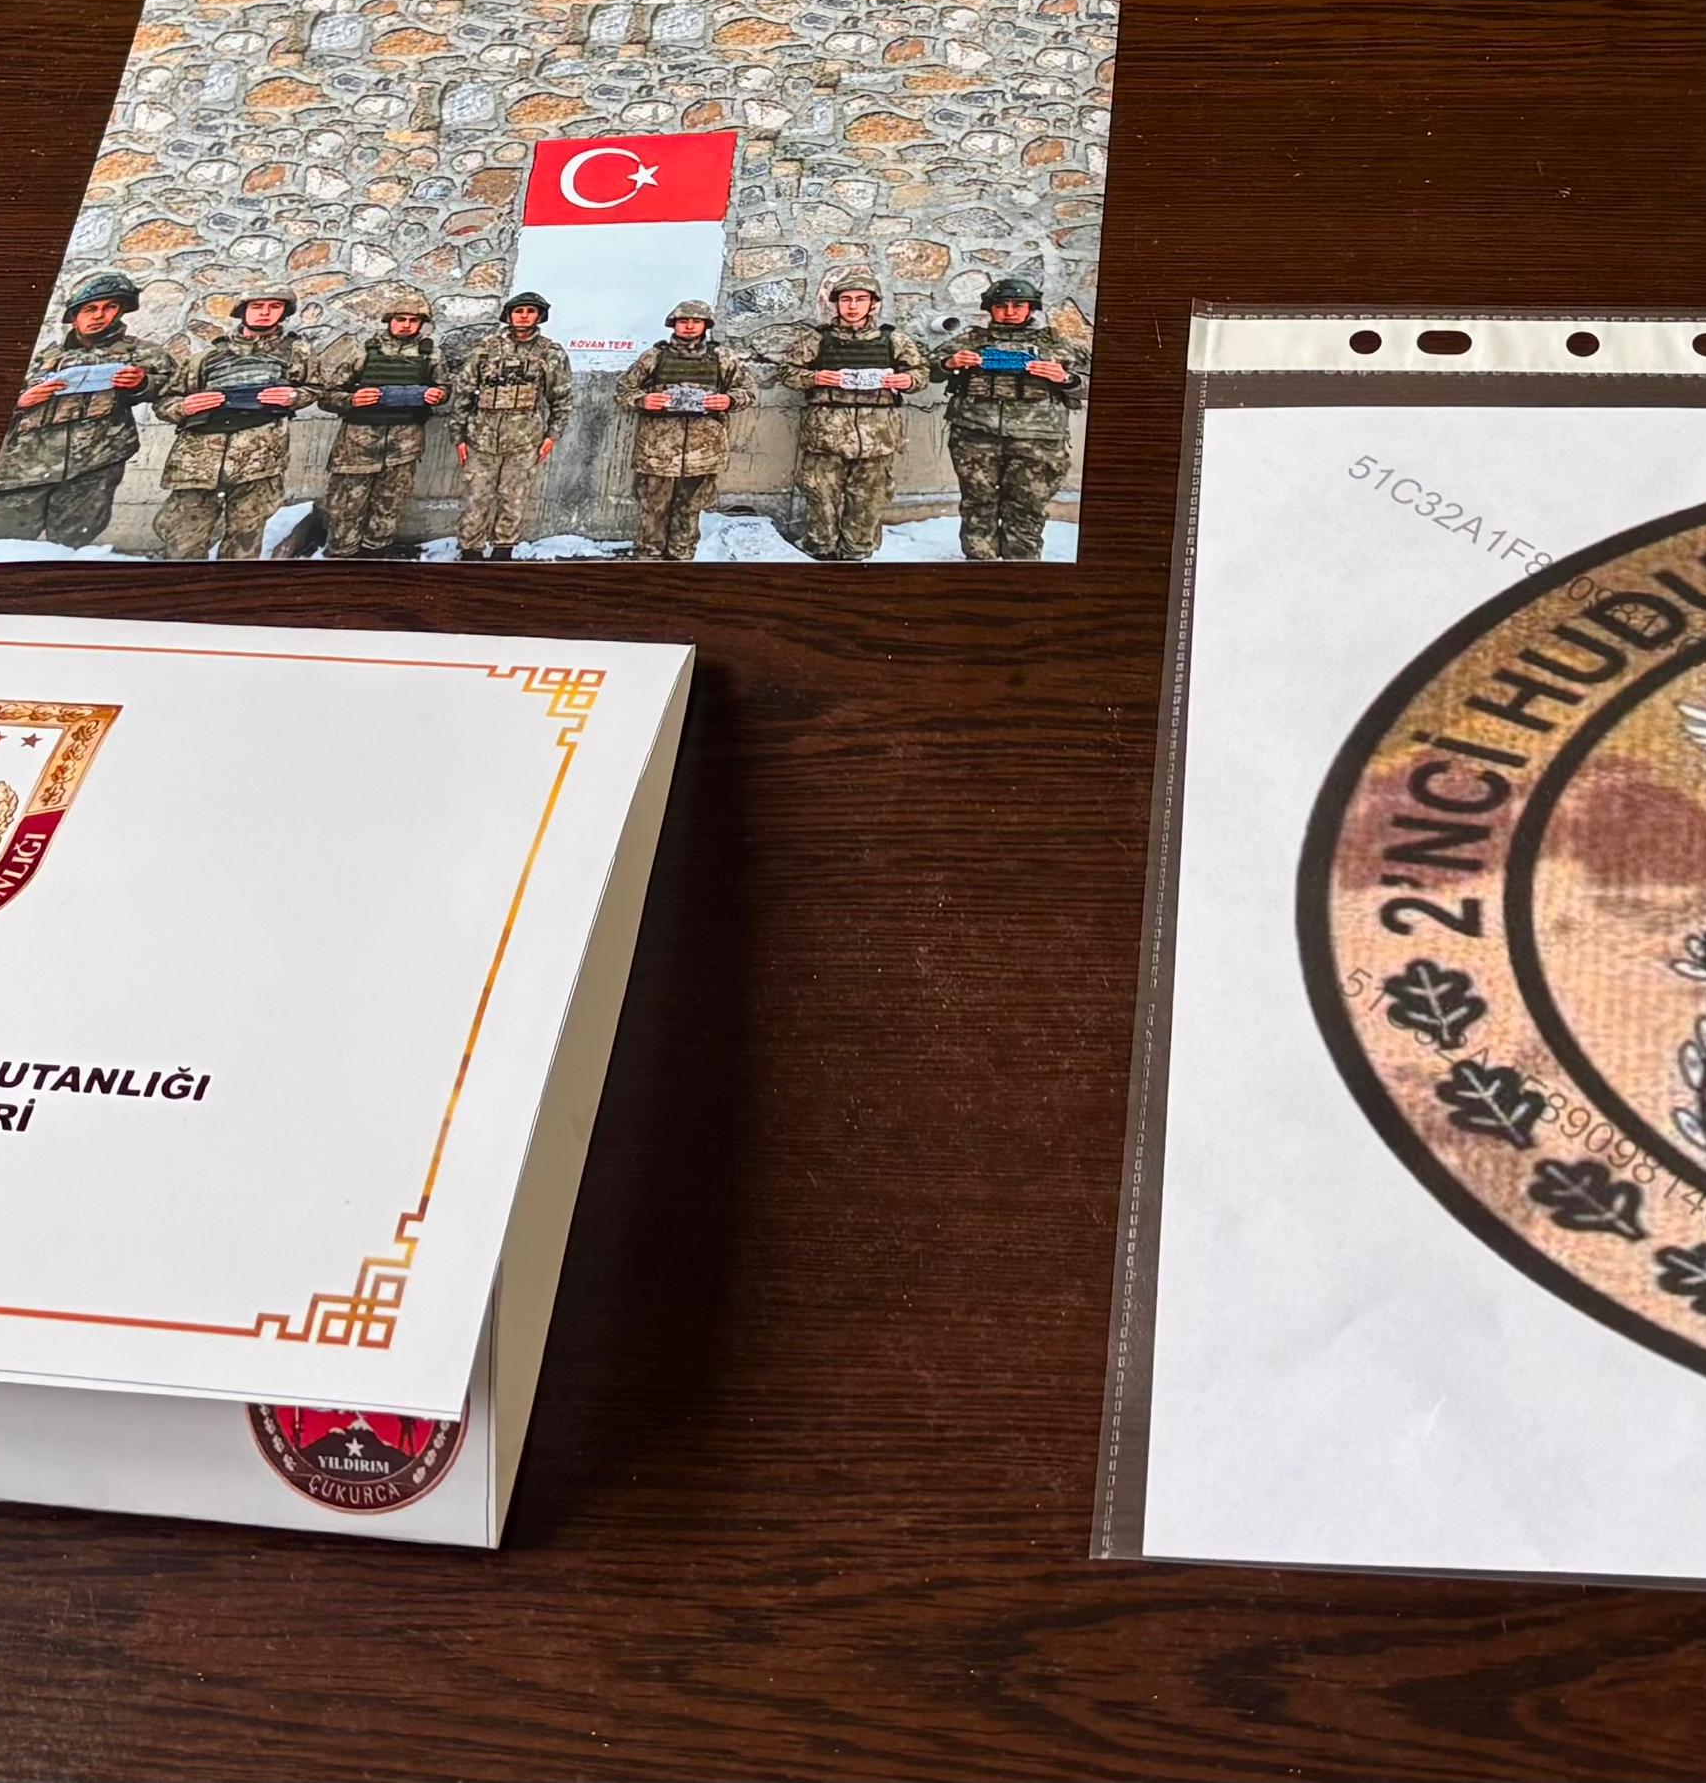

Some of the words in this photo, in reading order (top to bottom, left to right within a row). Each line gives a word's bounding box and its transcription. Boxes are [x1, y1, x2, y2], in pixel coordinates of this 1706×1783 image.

[1381, 730, 1527, 939] 2'NCİ
[317, 1454, 390, 1474] YILDIRIM
[308, 1474, 401, 1505] ÇUKURCA
